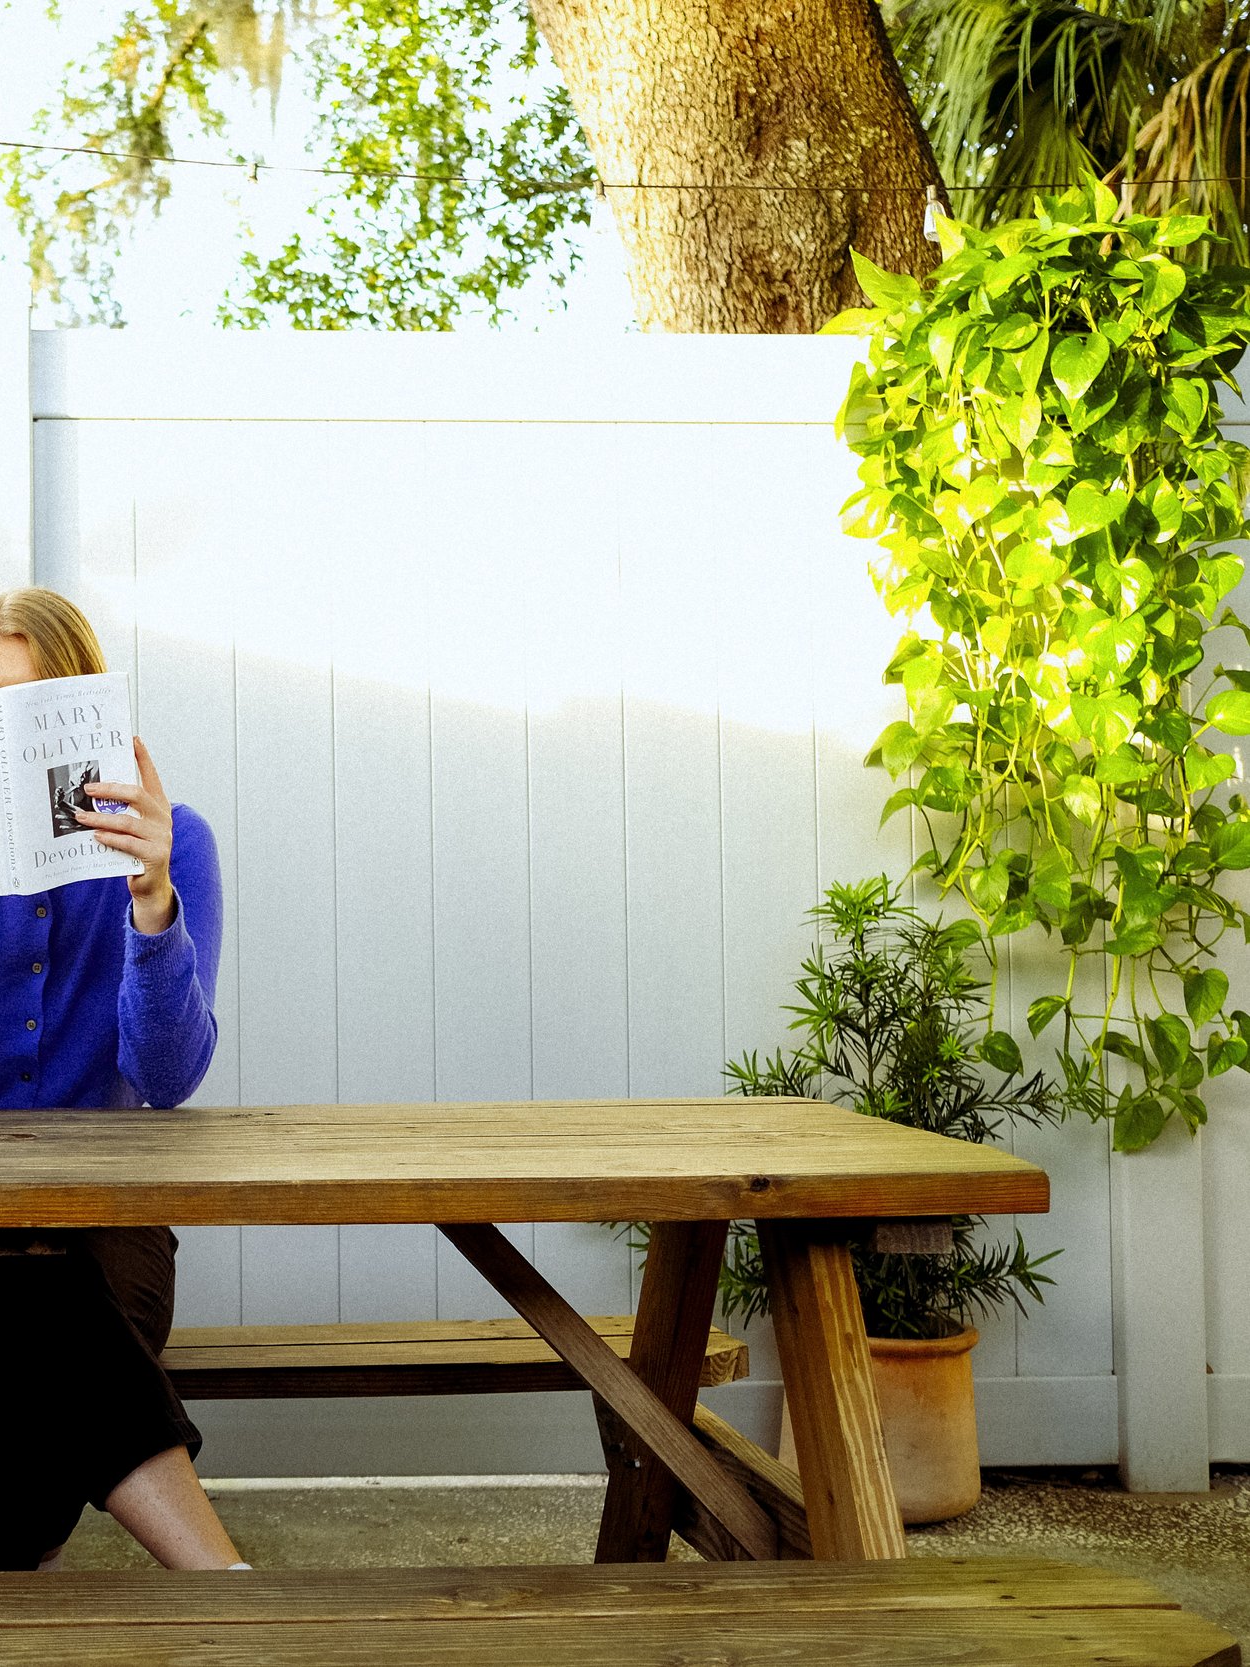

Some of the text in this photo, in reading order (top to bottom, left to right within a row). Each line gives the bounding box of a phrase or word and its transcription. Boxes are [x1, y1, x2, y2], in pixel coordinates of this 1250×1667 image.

[35, 703, 105, 733] MARY
[23, 730, 125, 764] OLIVER
[0, 750, 11, 804] OLIVER
[6, 812, 15, 871] Devotions
[97, 798, 123, 807] JENN
